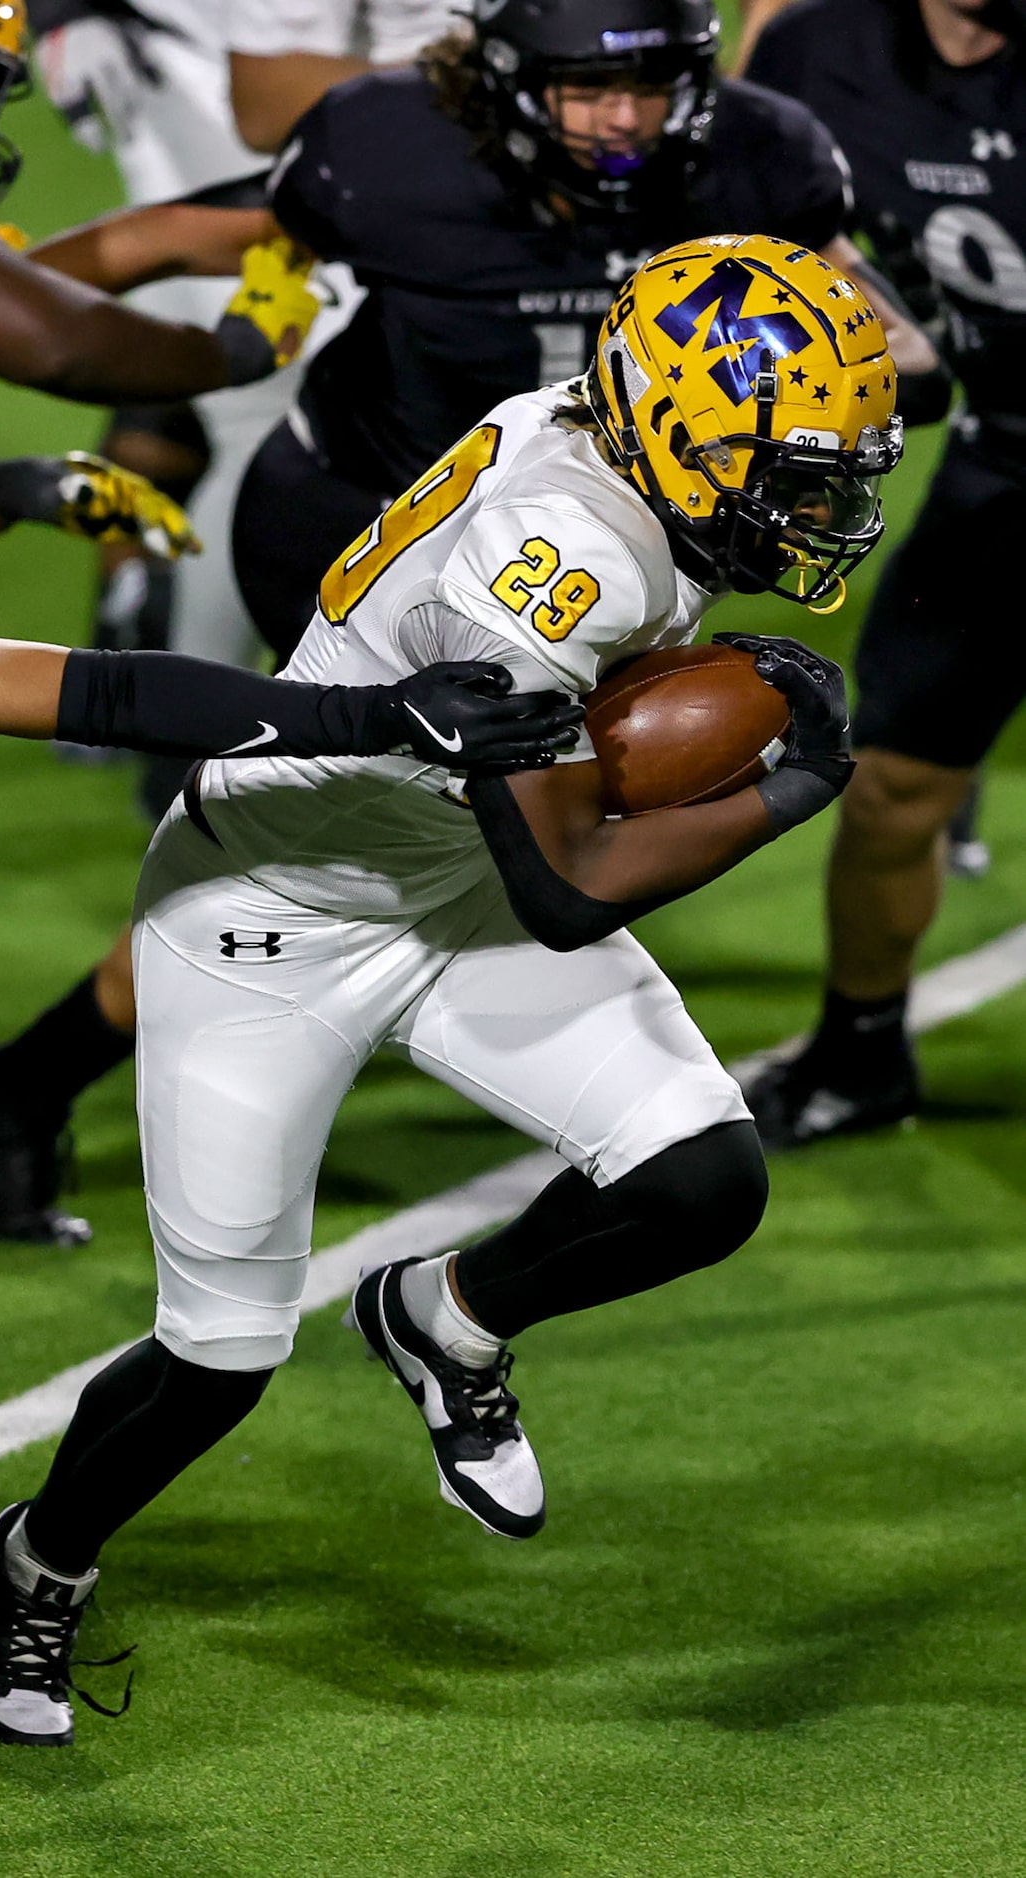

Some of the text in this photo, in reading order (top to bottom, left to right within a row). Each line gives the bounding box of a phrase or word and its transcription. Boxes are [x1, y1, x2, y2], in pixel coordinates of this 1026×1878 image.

[653, 257, 814, 408] M
[318, 424, 503, 627] 9
[489, 535, 601, 643] 29
